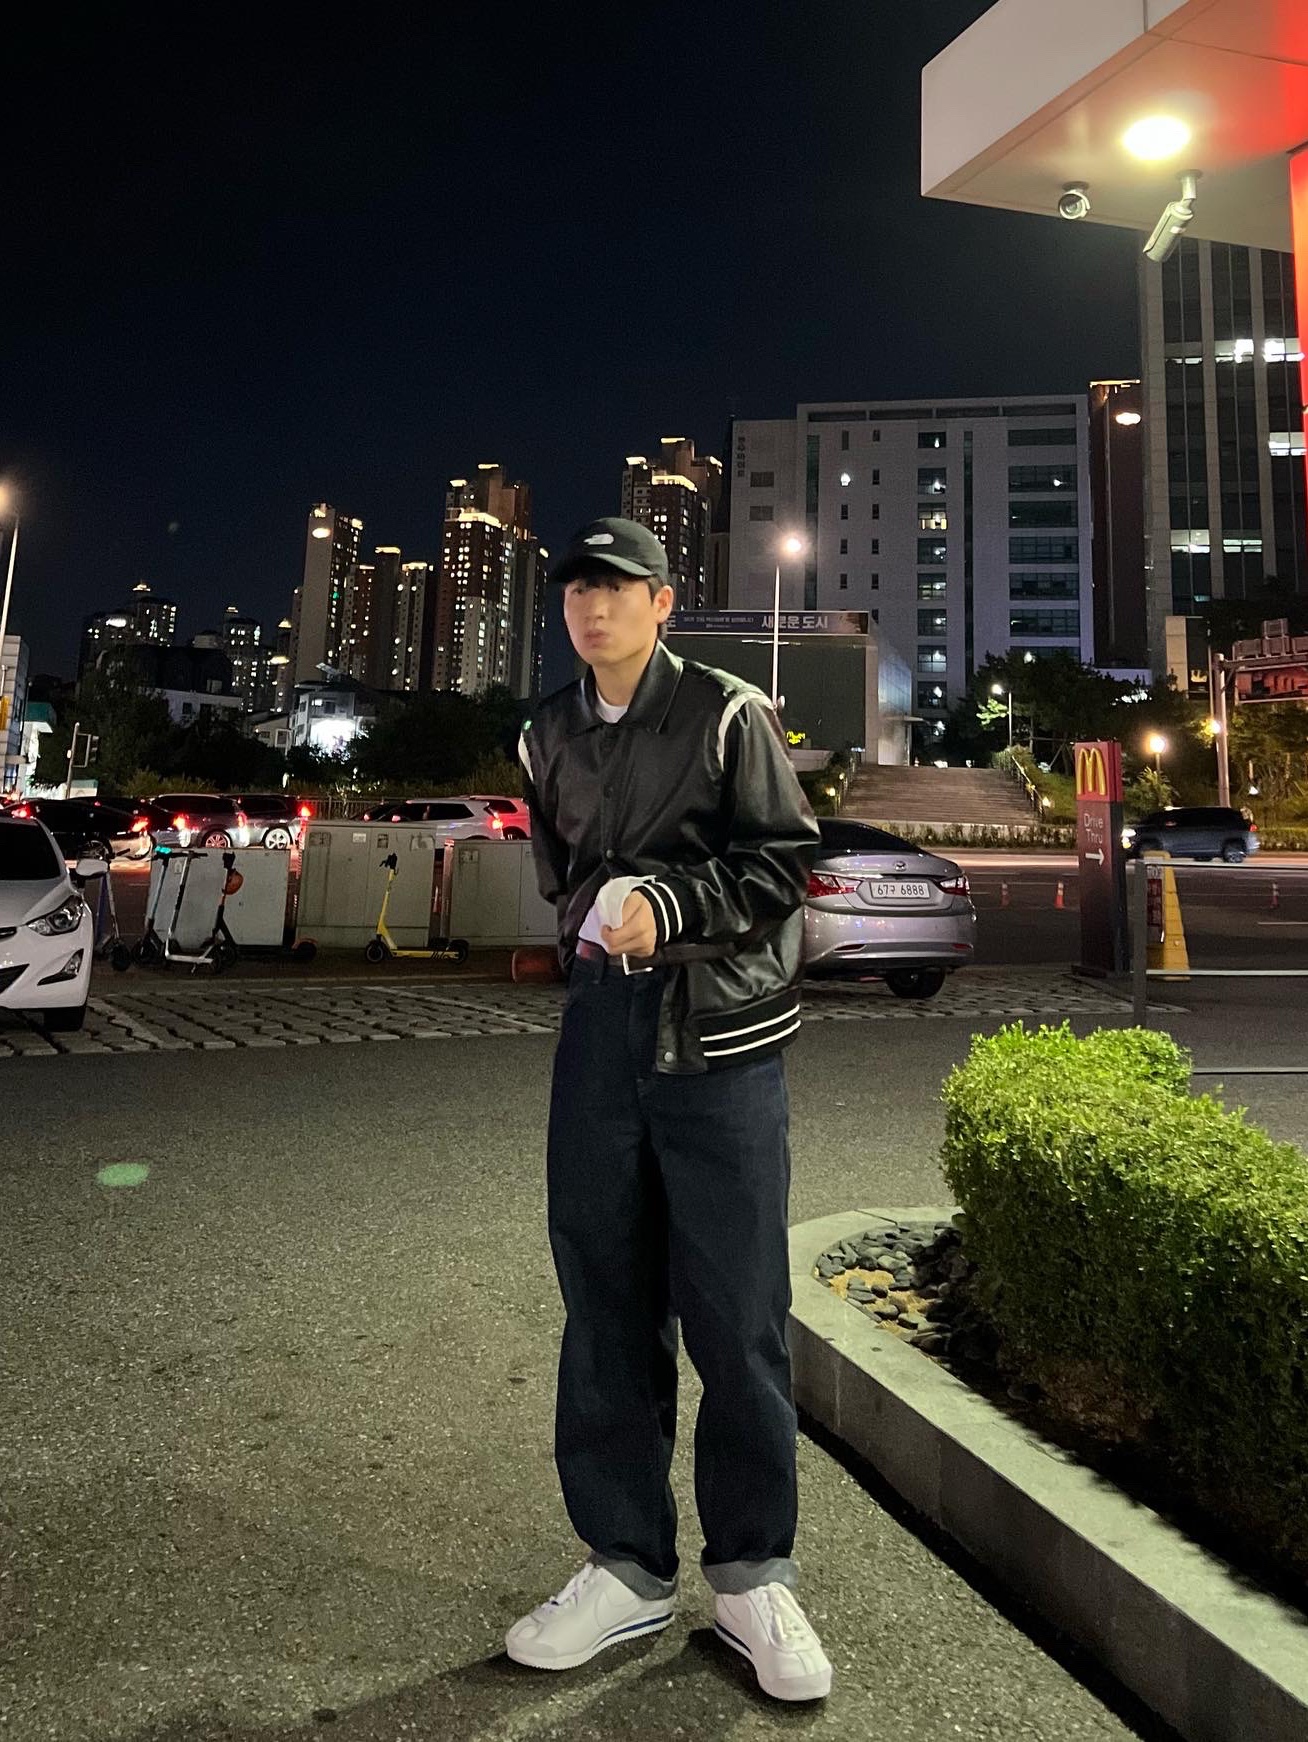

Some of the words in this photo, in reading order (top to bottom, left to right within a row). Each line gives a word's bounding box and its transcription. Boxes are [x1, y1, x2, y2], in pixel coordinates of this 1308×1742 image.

[761, 615, 800, 629] 새로운
[802, 615, 829, 629] 도시
[1083, 812, 1104, 829] Drive
[1085, 828, 1103, 845] Thru
[900, 884, 925, 896] 6888
